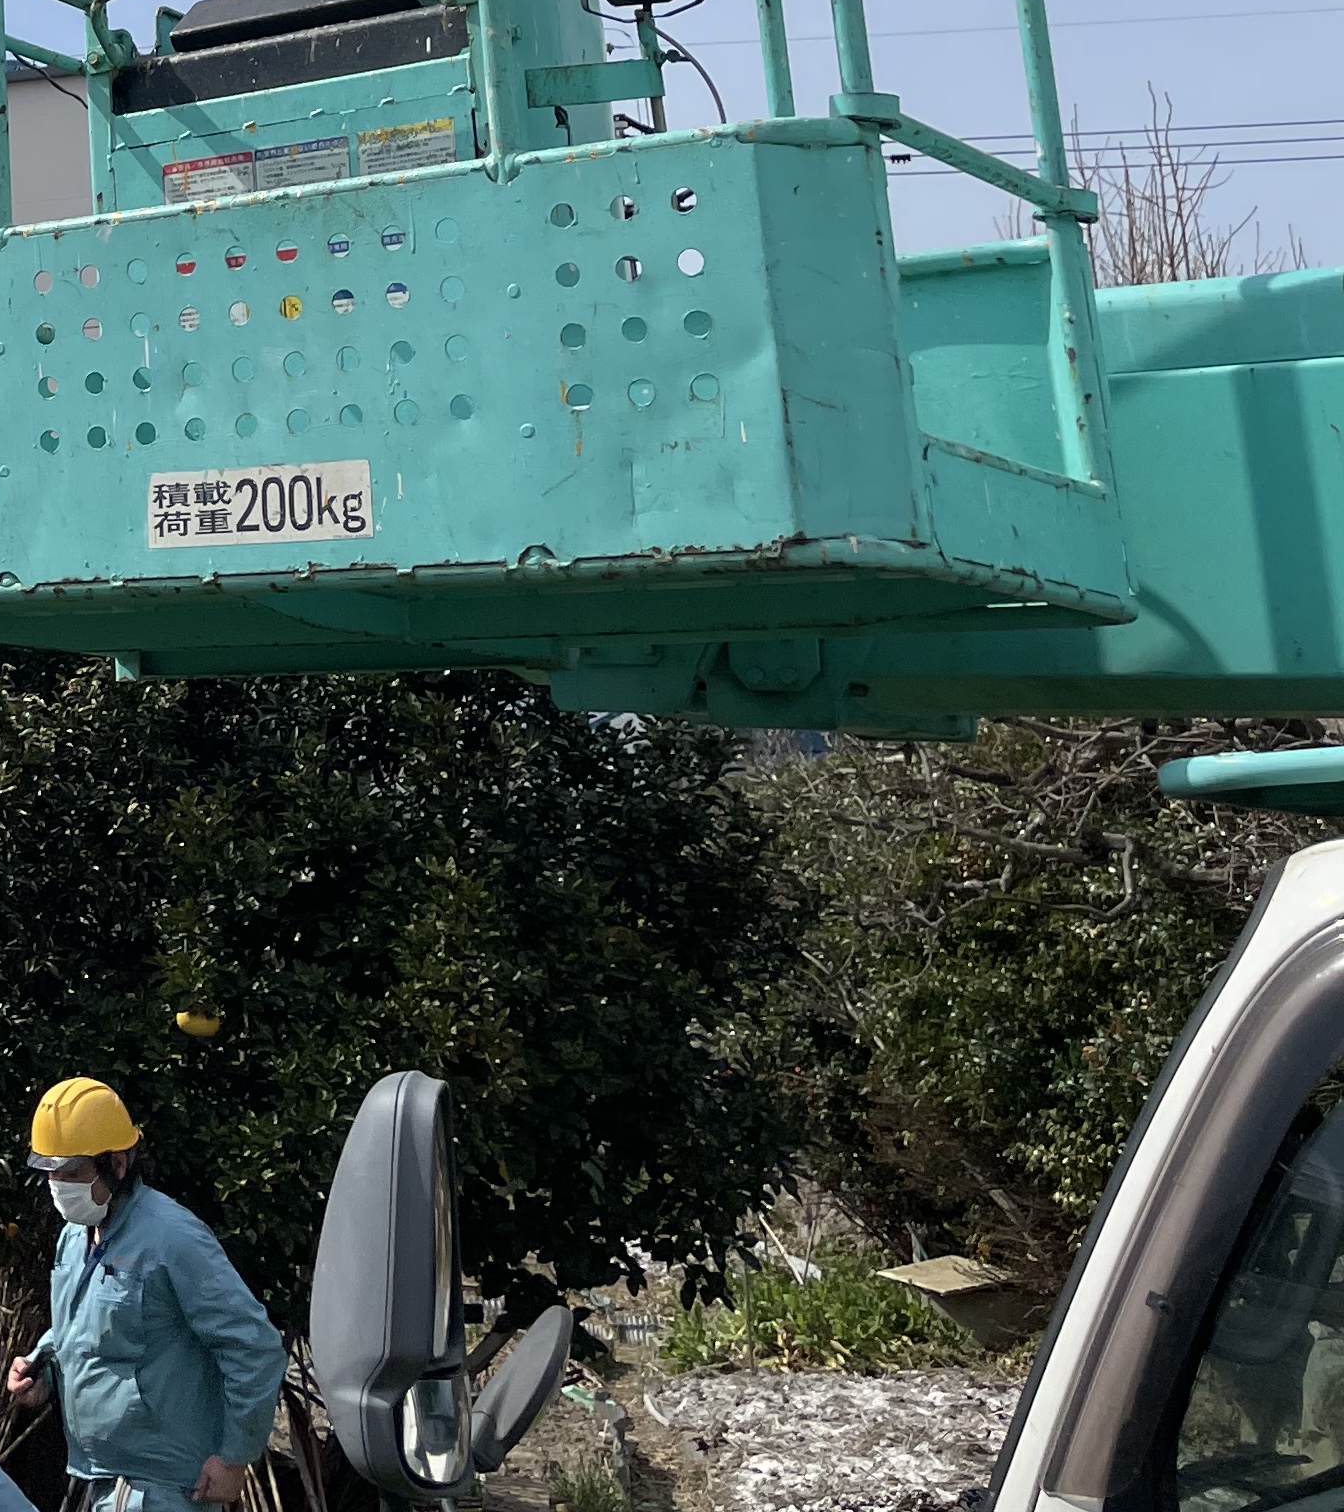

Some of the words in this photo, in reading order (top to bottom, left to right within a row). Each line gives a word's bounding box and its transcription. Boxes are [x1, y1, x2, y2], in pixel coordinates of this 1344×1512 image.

[153, 481, 232, 508] 積載
[234, 475, 366, 533] 200kg
[153, 508, 234, 537] 荷重
